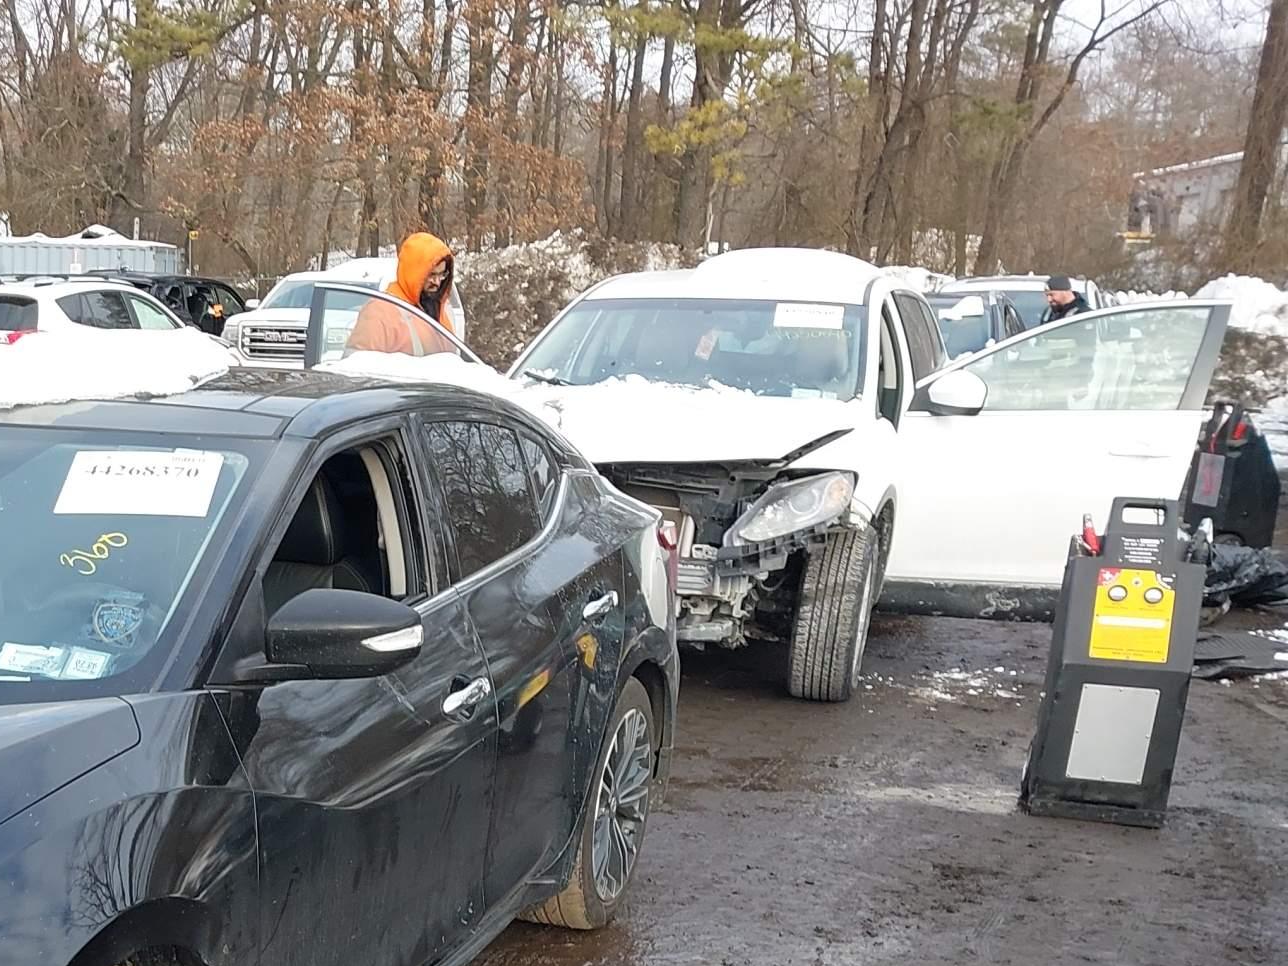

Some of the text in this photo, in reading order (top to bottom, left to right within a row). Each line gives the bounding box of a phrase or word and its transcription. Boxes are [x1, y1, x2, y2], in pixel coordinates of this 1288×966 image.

[264, 331, 298, 342] GMC
[85, 464, 199, 478] 44268370
[59, 532, 128, 576] 360
